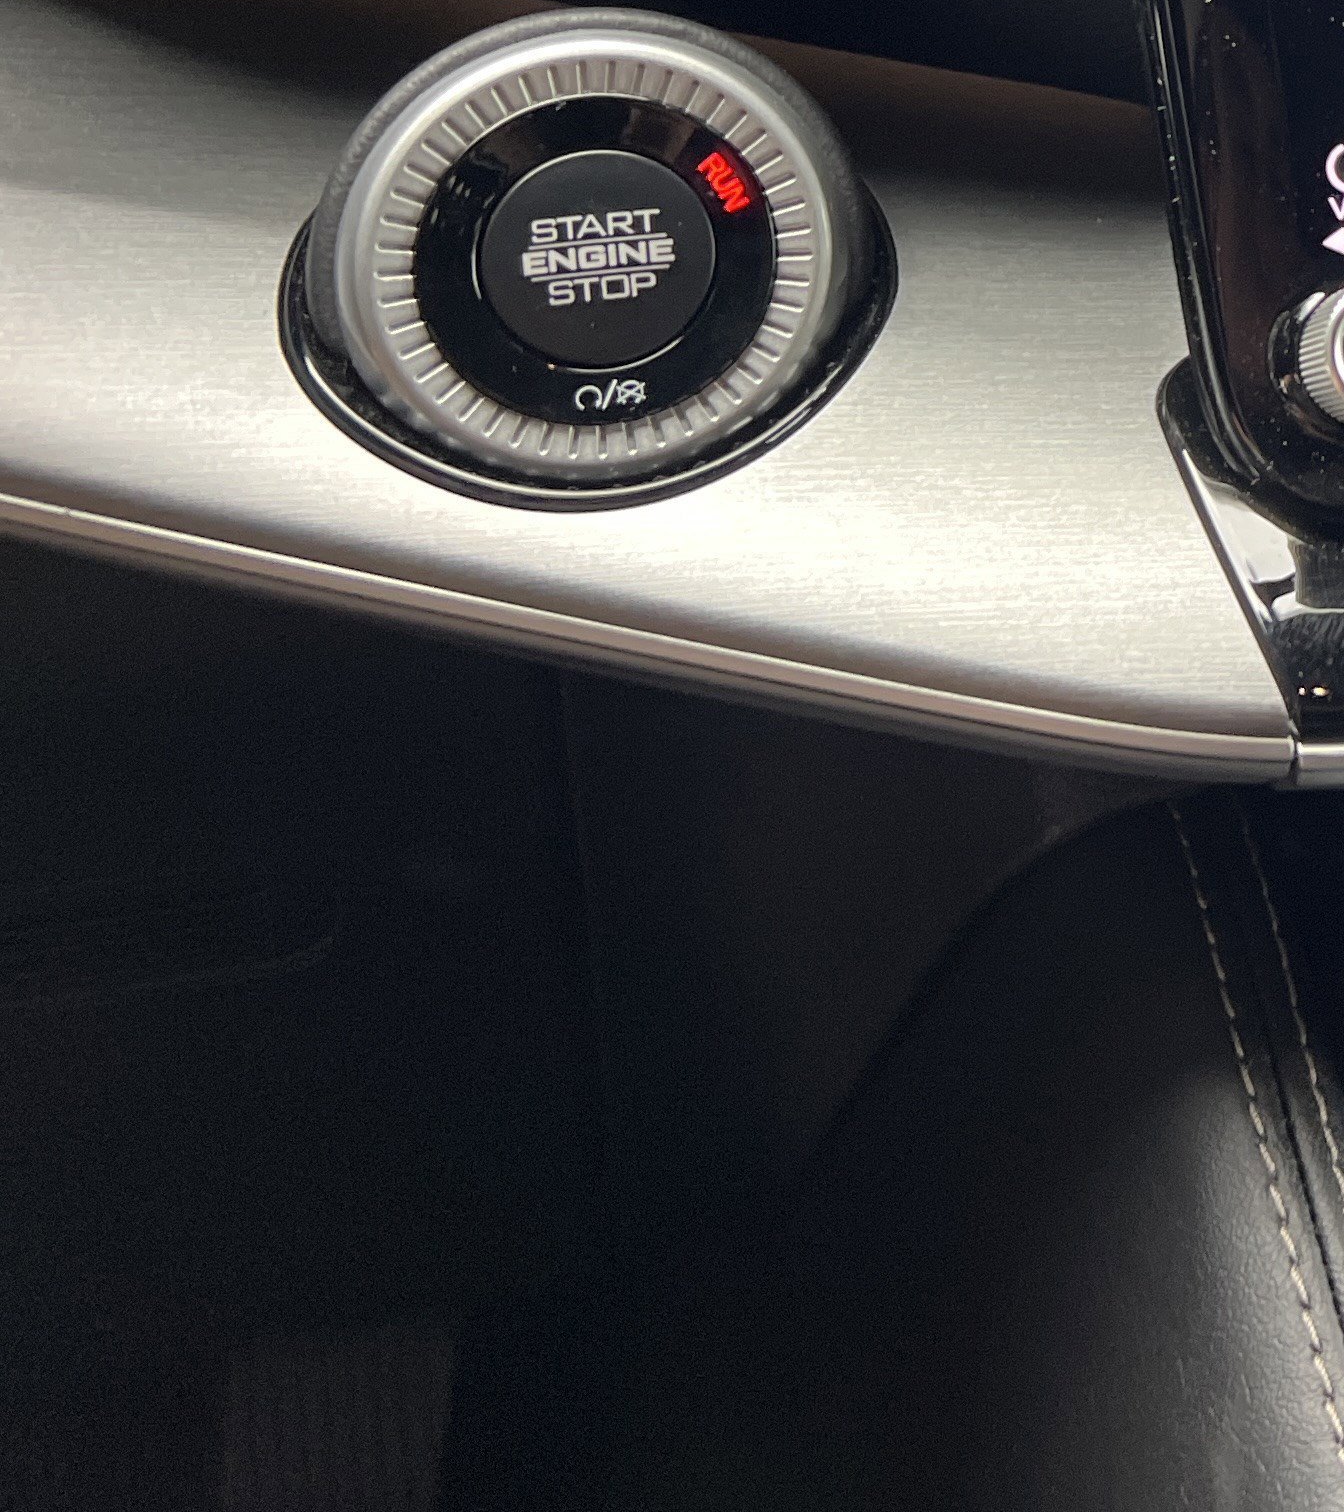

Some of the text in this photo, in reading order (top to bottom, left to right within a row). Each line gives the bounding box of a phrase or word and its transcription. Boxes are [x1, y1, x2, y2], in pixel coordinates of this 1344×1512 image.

[696, 151, 752, 214] RUN
[530, 207, 661, 244] START
[521, 237, 676, 279] ENGINE
[547, 272, 658, 307] STOP
